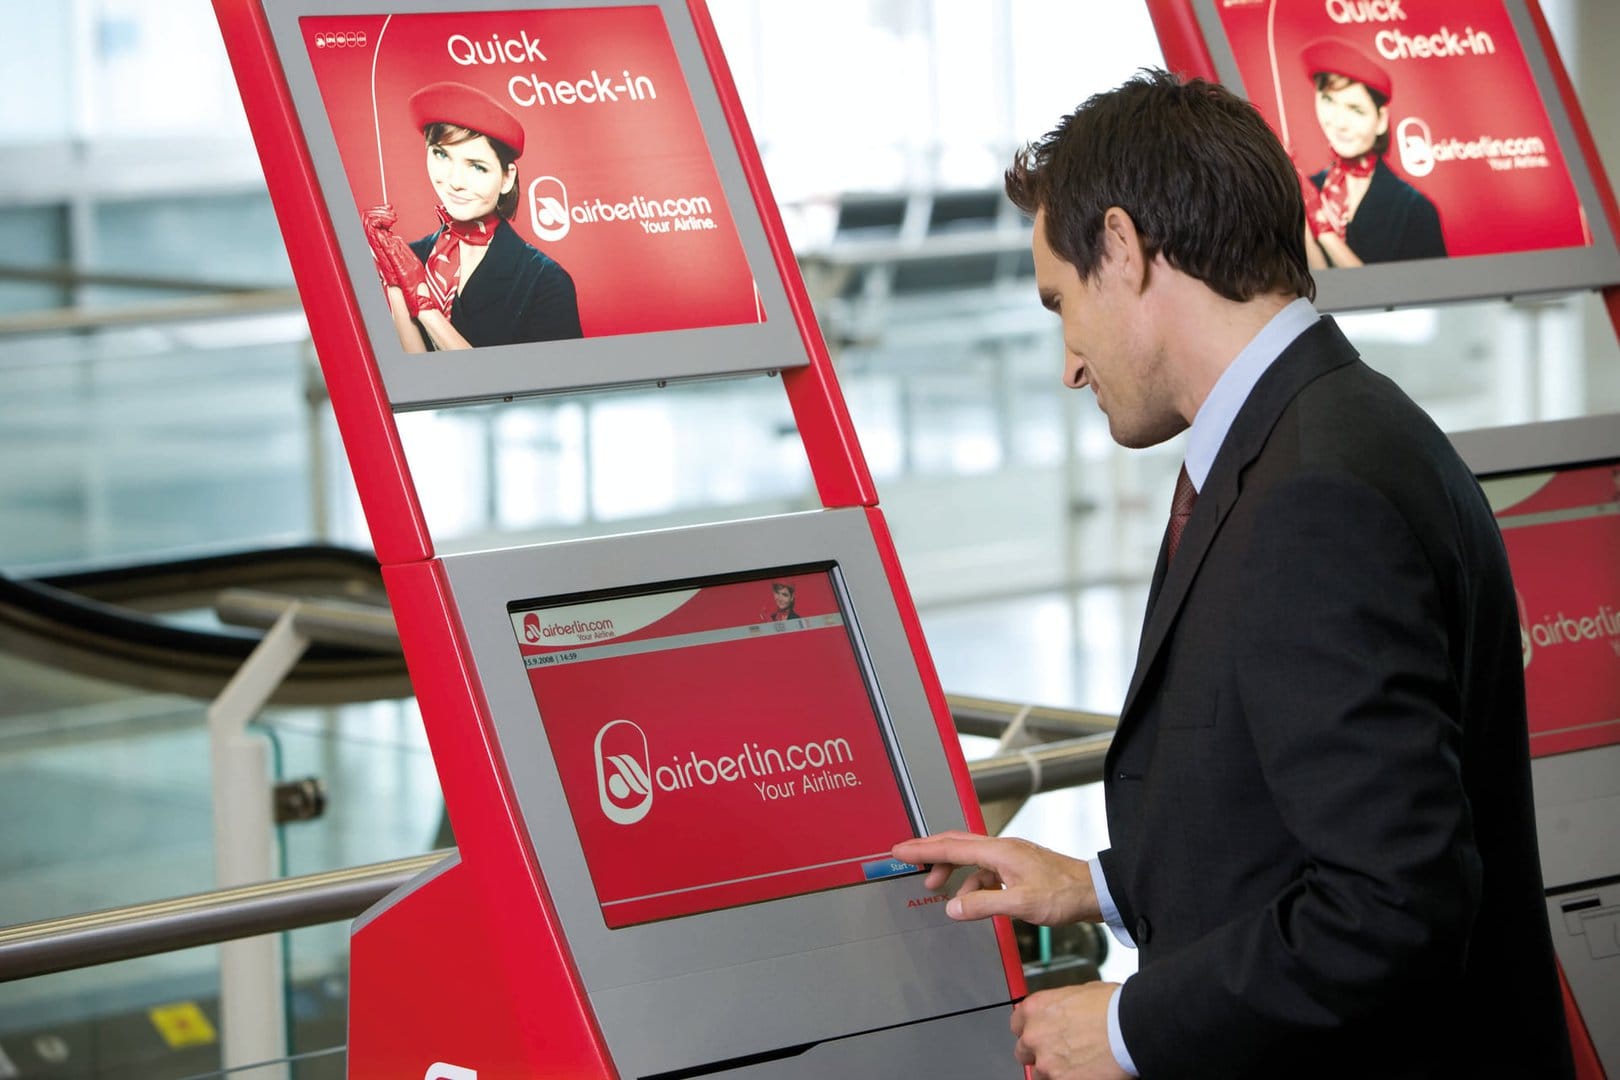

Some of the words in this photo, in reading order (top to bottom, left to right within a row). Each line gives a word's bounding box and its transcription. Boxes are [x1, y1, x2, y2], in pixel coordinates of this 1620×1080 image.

[1325, 0, 1408, 24] Quick
[447, 30, 547, 66] Quick
[1375, 26, 1496, 60] Check-in
[508, 70, 656, 107] Check-in
[571, 196, 712, 224] airberlin.com
[640, 220, 671, 234] Your
[674, 216, 718, 231] Airline.
[542, 619, 613, 637] airberlin.com
[655, 737, 853, 791] airberlin.com
[754, 780, 795, 800] Your
[802, 771, 862, 793] Airline.
[890, 862, 908, 872] Start
